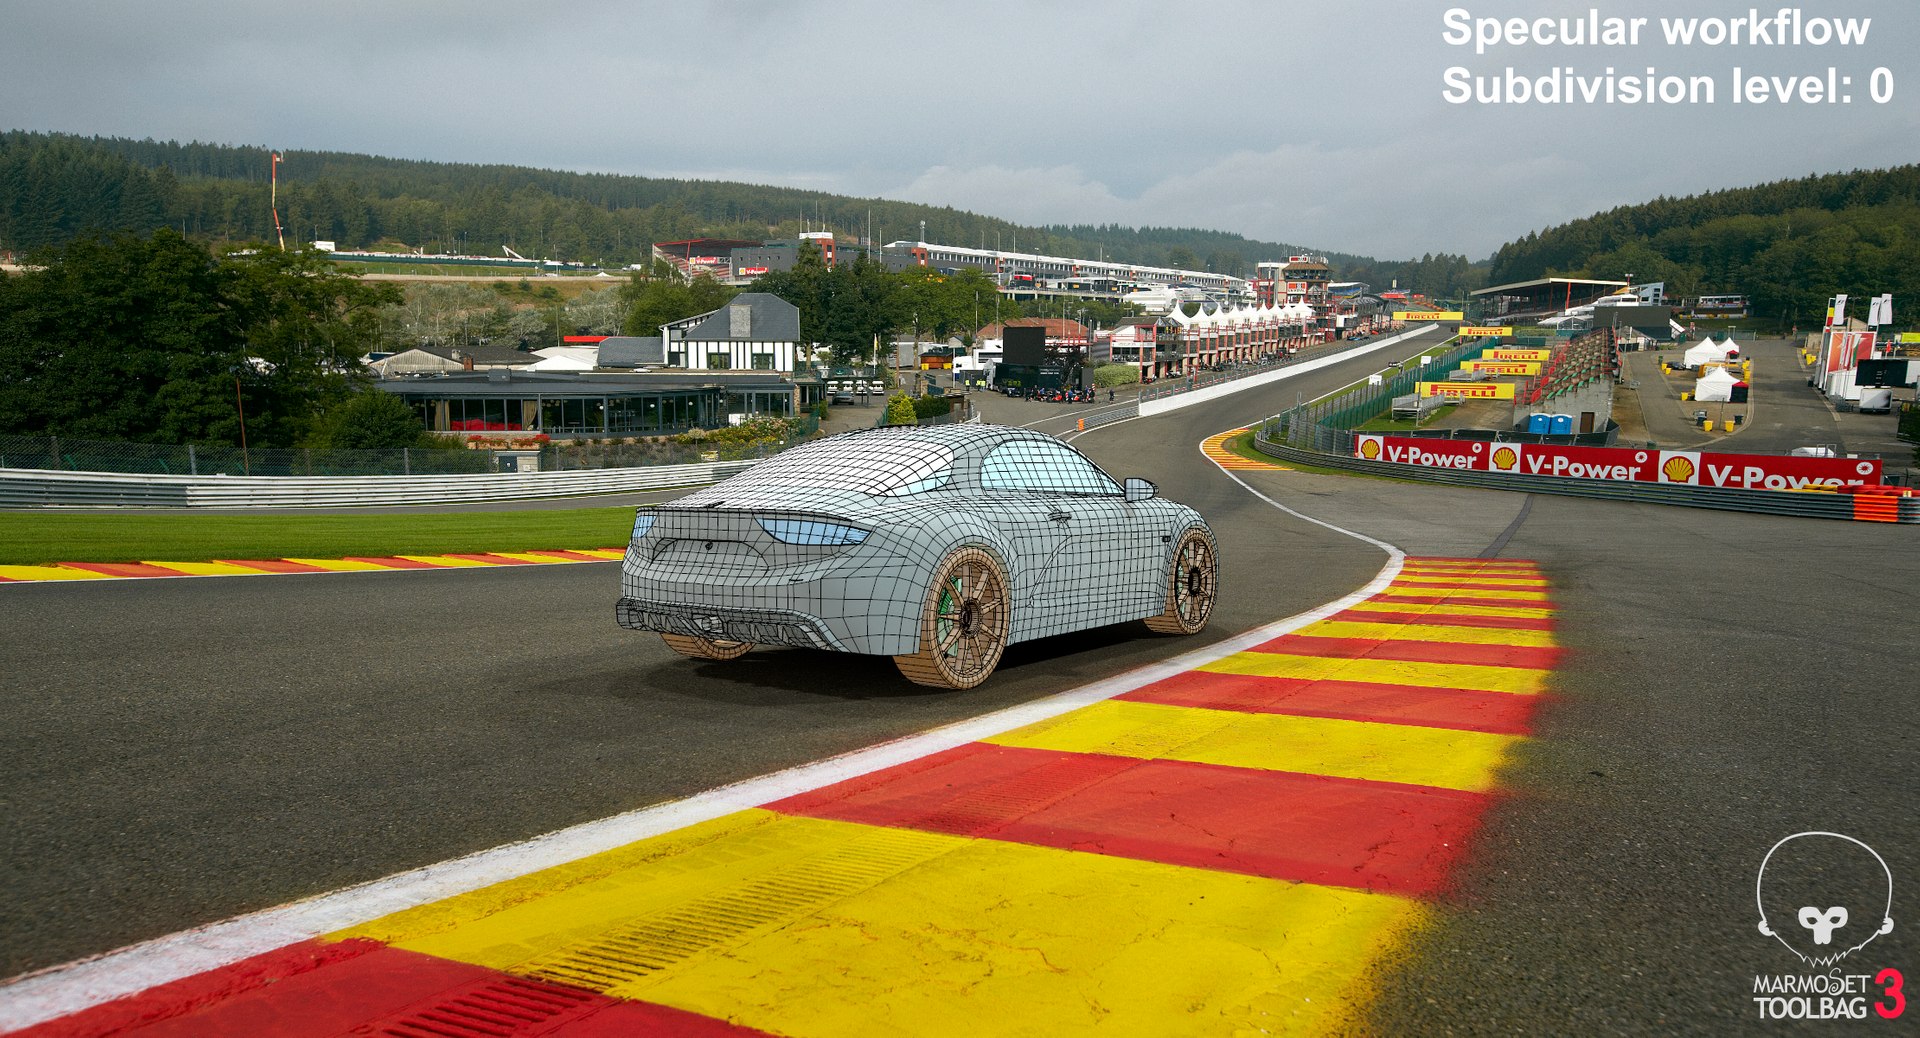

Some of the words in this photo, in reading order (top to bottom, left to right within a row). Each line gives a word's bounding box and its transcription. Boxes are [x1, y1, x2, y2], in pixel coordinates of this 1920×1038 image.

[1406, 312, 1440, 320] PIRELLI
[1493, 351, 1539, 360] PIRELLI
[1473, 363, 1527, 374] PRELLI
[1430, 384, 1497, 397] PIRELLI
[1387, 445, 1477, 469] V-Power
[1526, 454, 1642, 481] V-Power
